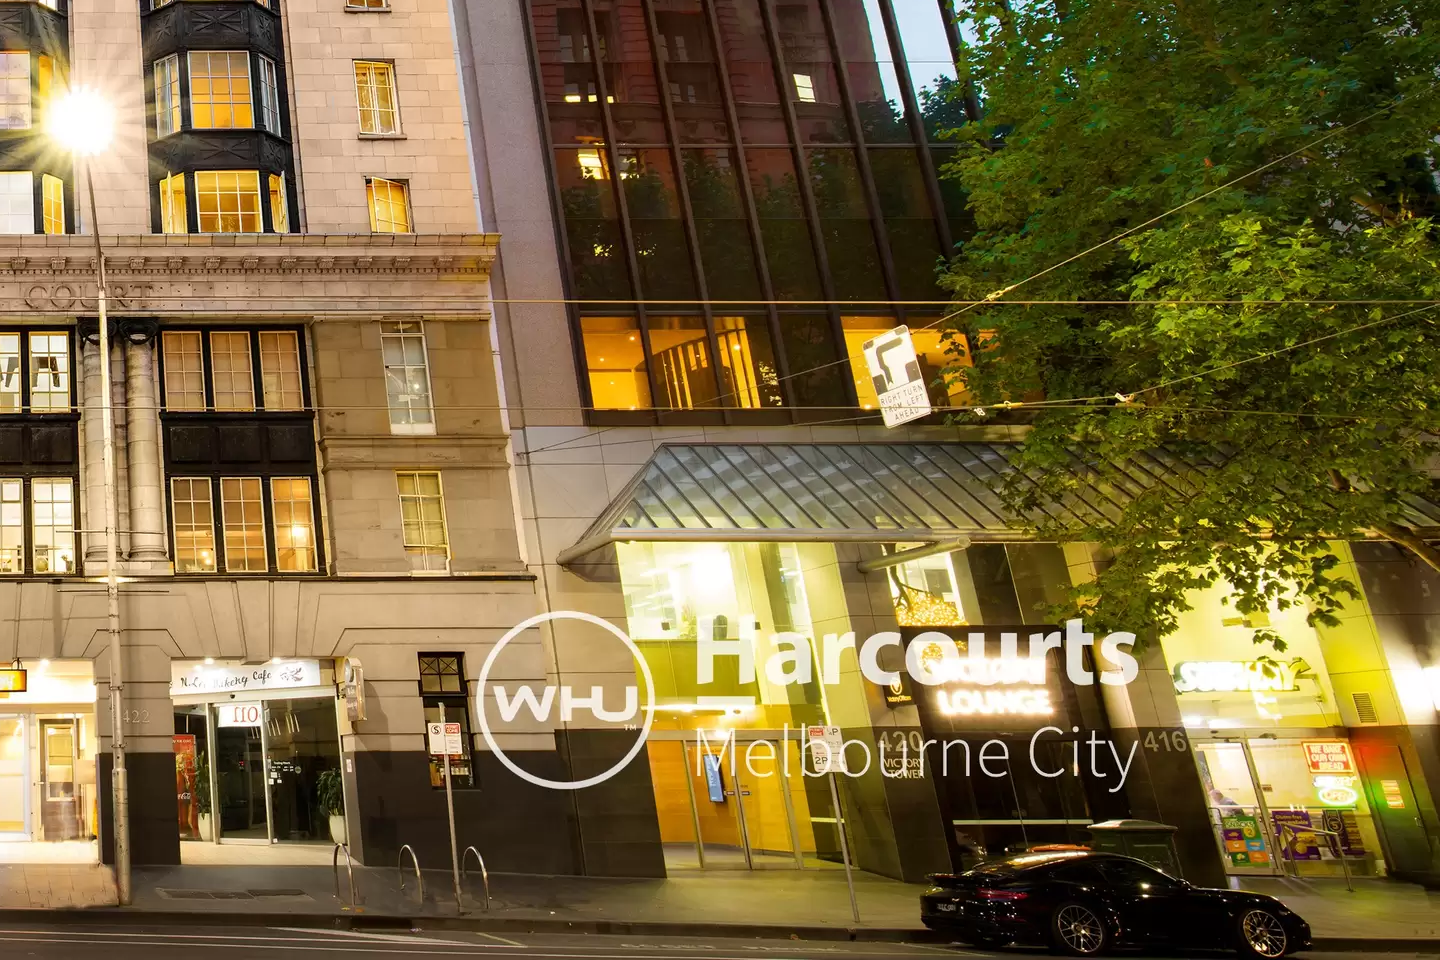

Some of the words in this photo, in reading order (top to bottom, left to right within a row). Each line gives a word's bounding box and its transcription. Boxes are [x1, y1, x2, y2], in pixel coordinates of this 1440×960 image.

[24, 285, 154, 310] COURT
[880, 392, 901, 406] RIGHT
[903, 384, 923, 397] TURN
[883, 401, 903, 414] FROM
[906, 393, 924, 407] LEFT
[895, 407, 920, 420] AHEAD
[937, 690, 1054, 715] LOUNGE
[122, 709, 150, 723] 422
[877, 730, 924, 752] 420
[1144, 731, 1187, 753] 416
[1310, 745, 1323, 754] WE
[1323, 745, 1344, 754] BAKE
[815, 756, 828, 765] 2P
[883, 758, 925, 768] VICTORY
[1311, 753, 1329, 762] OUR
[888, 769, 925, 779] TOWER
